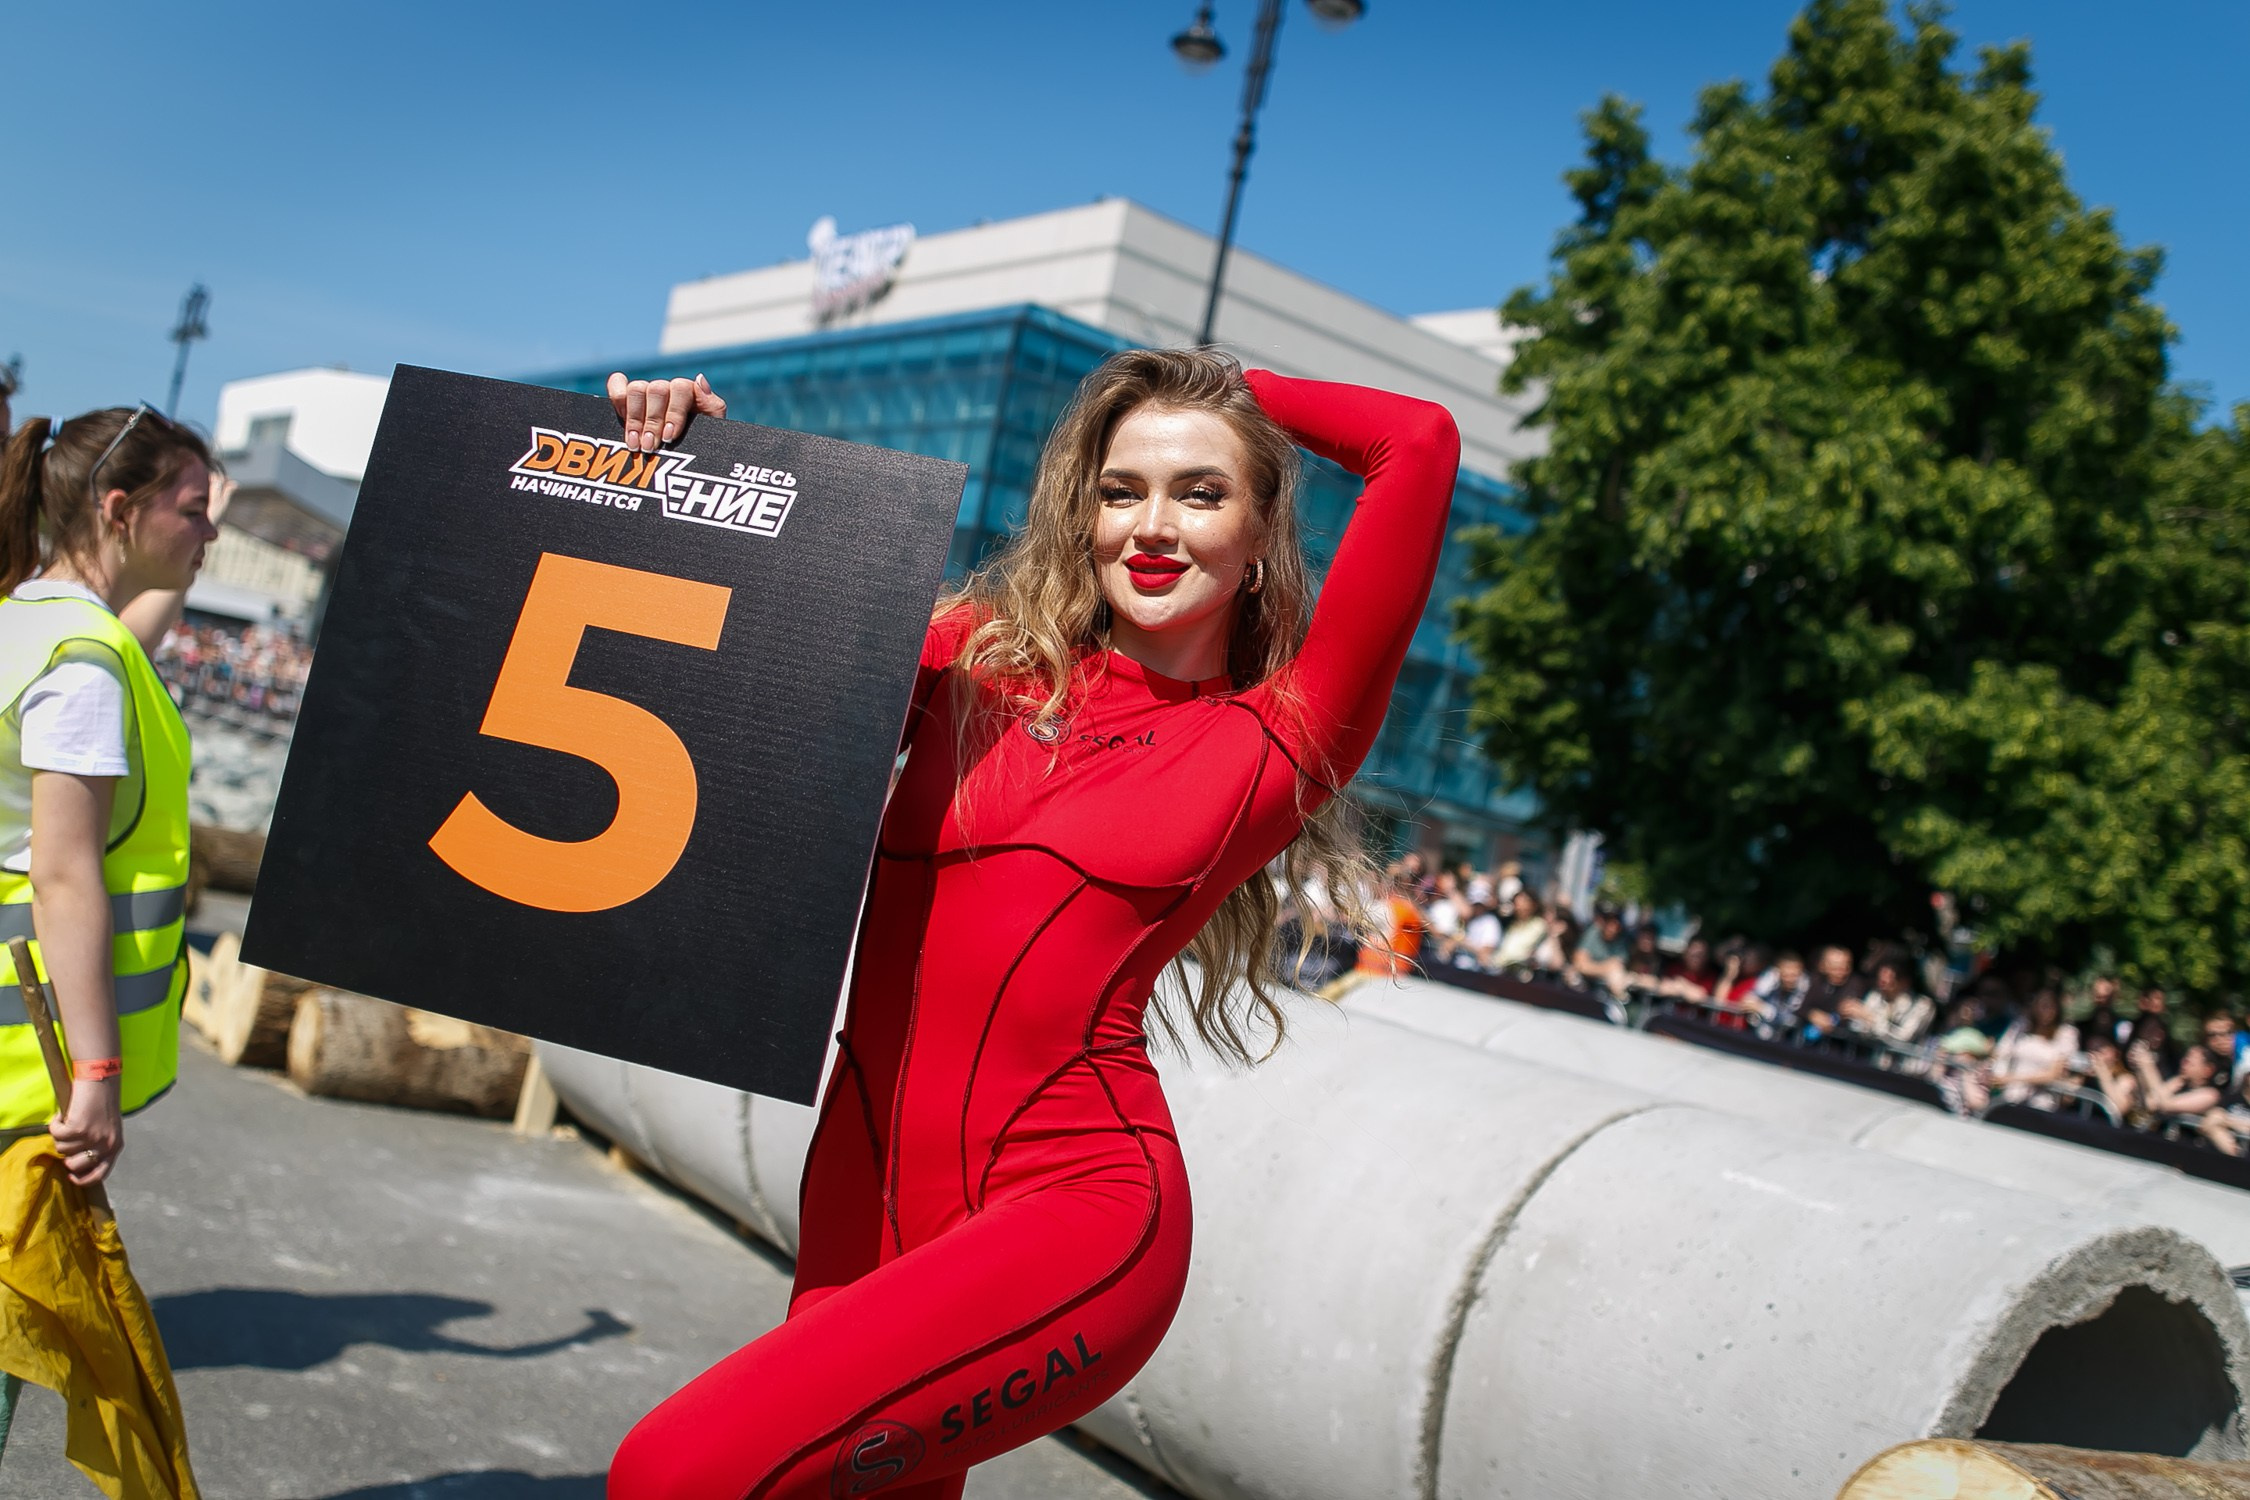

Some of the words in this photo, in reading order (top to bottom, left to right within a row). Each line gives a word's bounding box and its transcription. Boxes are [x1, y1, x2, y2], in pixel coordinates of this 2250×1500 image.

[510, 475, 643, 512] НАЧИНАЕТСЯ
[729, 462, 797, 488] ЗДЕСЬ
[427, 551, 733, 913] 5
[939, 1331, 1103, 1444] SEGAL
